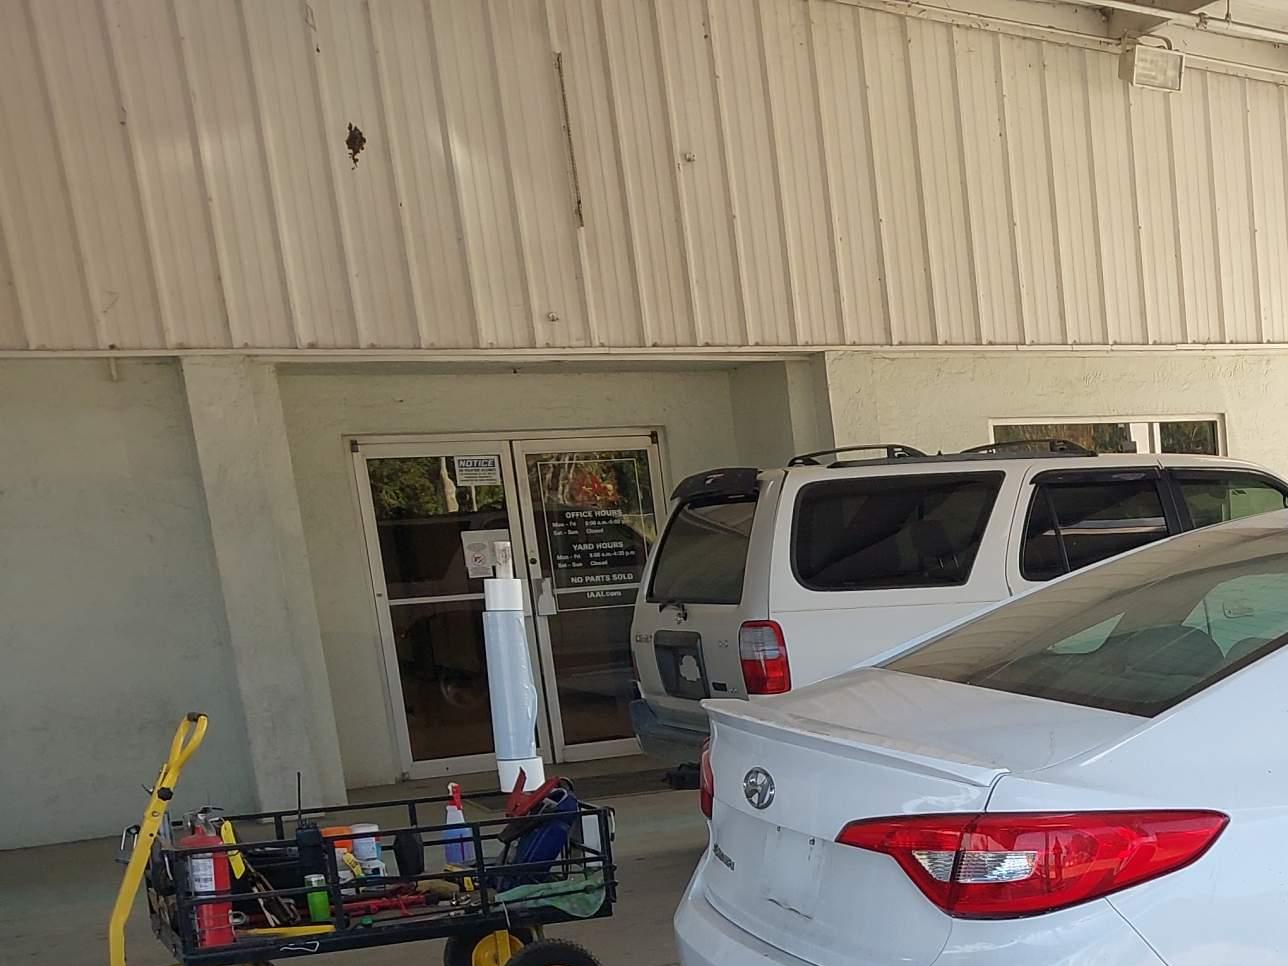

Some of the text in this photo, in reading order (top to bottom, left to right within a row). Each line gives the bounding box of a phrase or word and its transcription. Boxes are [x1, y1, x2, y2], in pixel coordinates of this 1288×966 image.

[459, 459, 495, 467] NOTICE
[565, 509, 623, 519] OFFICE HOURS
[572, 541, 624, 551] YARD HOURS
[585, 574, 610, 582] PARTS
